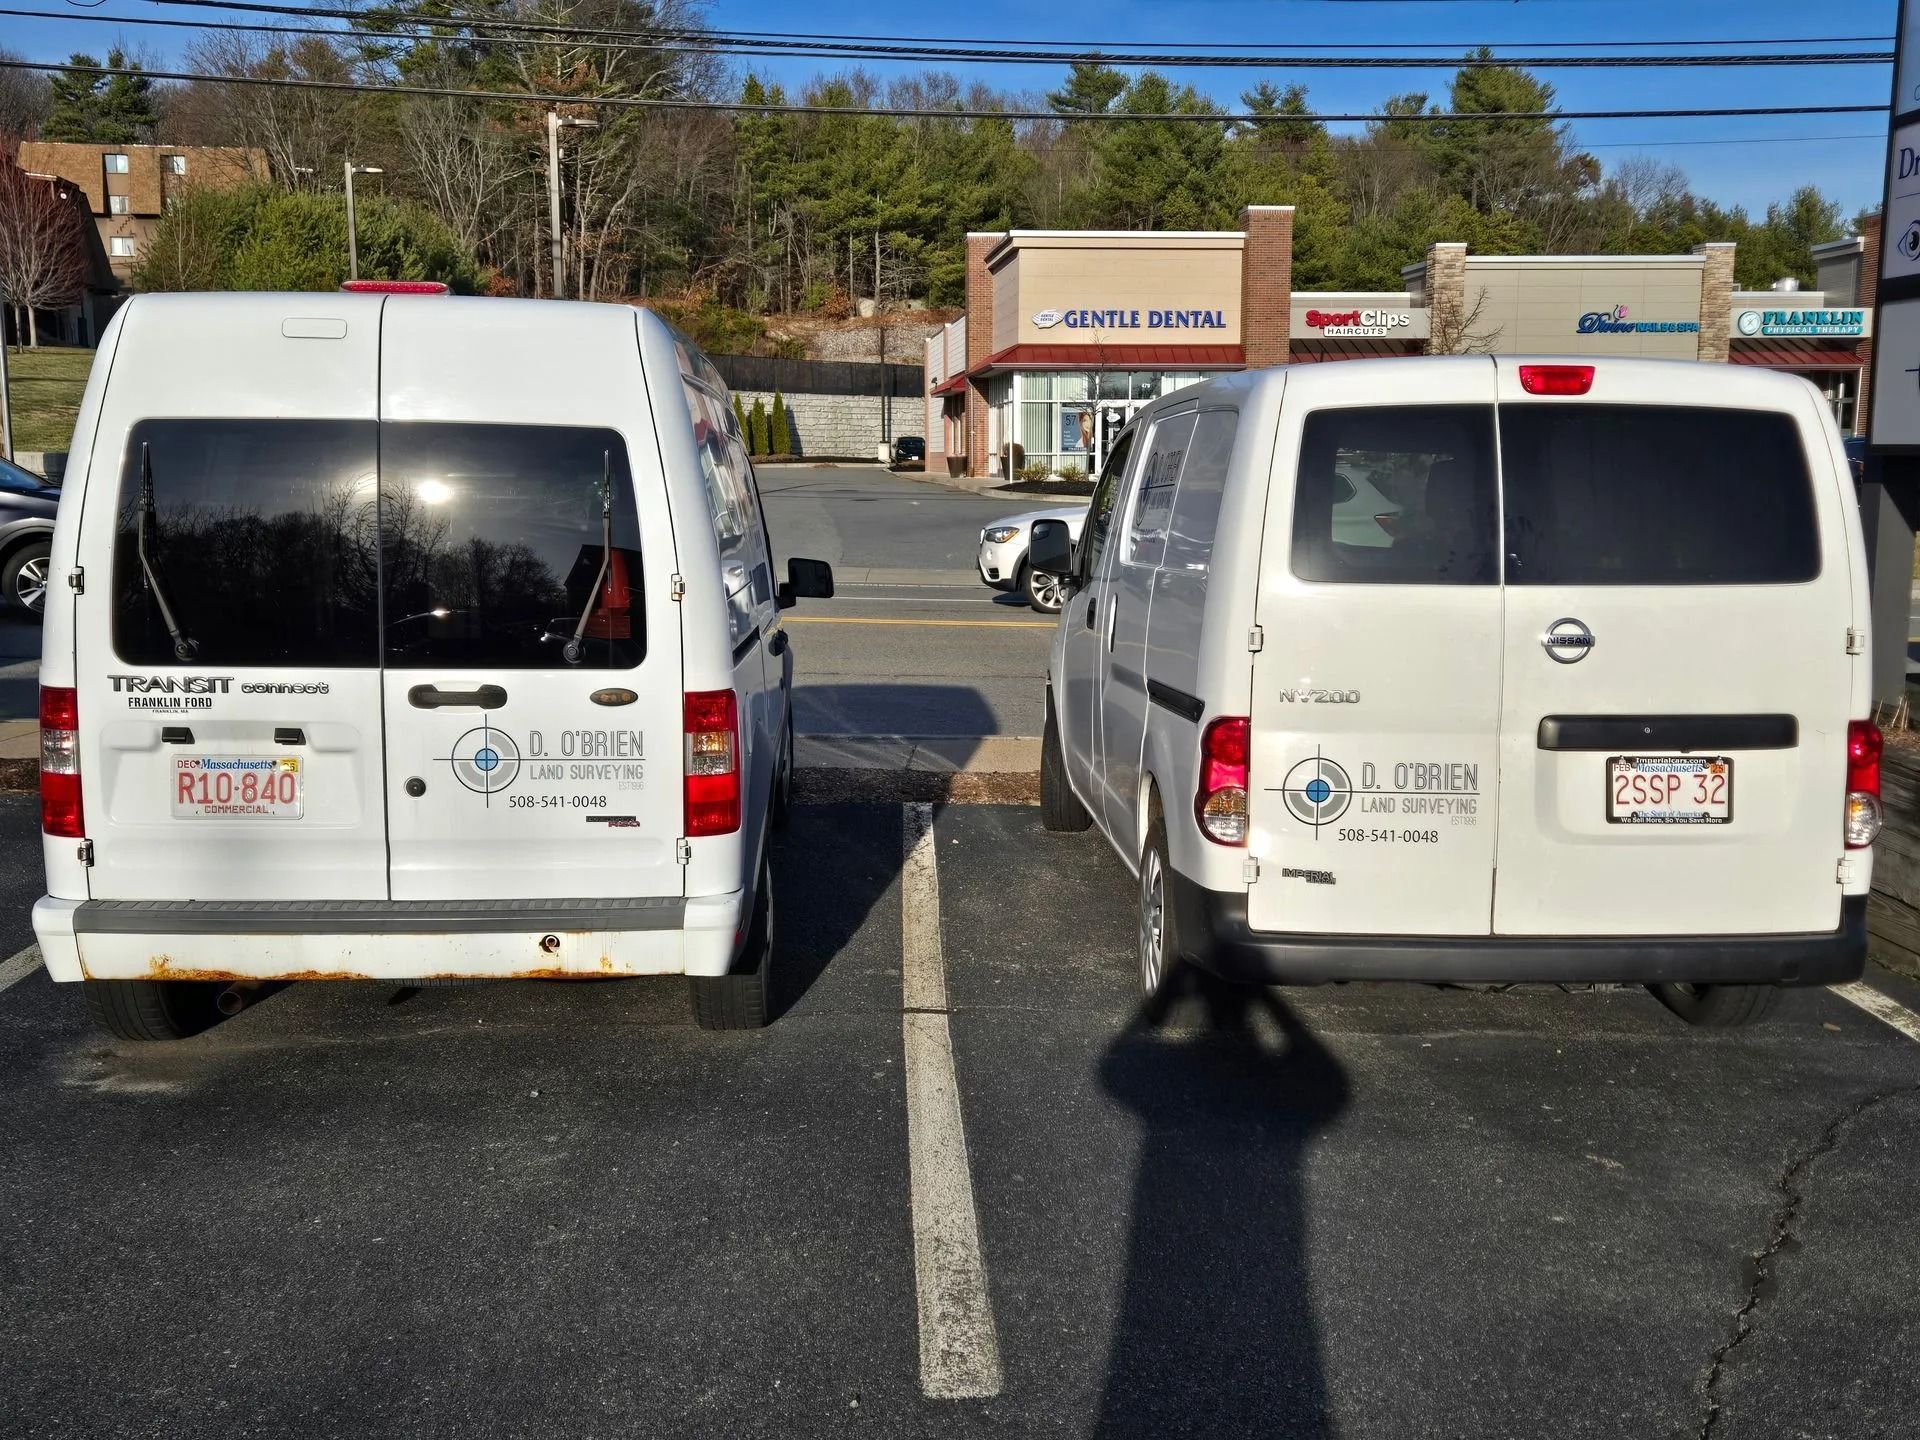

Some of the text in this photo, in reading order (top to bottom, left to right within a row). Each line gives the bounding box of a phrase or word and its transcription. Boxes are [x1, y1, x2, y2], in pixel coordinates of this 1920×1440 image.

[1063, 309, 1226, 328] GENTLE DENTAL
[1761, 311, 1864, 325] FRANKLIN
[1065, 415, 1076, 426] 57
[1547, 636, 1591, 645] NISSAN
[107, 675, 329, 694] TRANSIT connect
[128, 697, 213, 708] FRANKLIN FORD
[1280, 689, 1361, 704] NV200
[529, 731, 644, 757] D. O'BRIEN
[177, 760, 196, 769] DEC
[200, 758, 273, 770] Massachusetts
[1614, 764, 1631, 772] FEB
[1635, 764, 1704, 773] Massachusetts
[530, 764, 644, 780] LAND SURVEYING
[1362, 762, 1478, 791] D. O'BRIEN
[1615, 774, 1726, 805] 2SSP 32
[509, 796, 607, 808] 508-541-0048
[1361, 797, 1477, 815] LAND SURVEYING
[204, 805, 269, 814] COMMERCIAL
[1338, 828, 1439, 843] 508-541-0048
[1282, 868, 1334, 879] IMPERIAL
